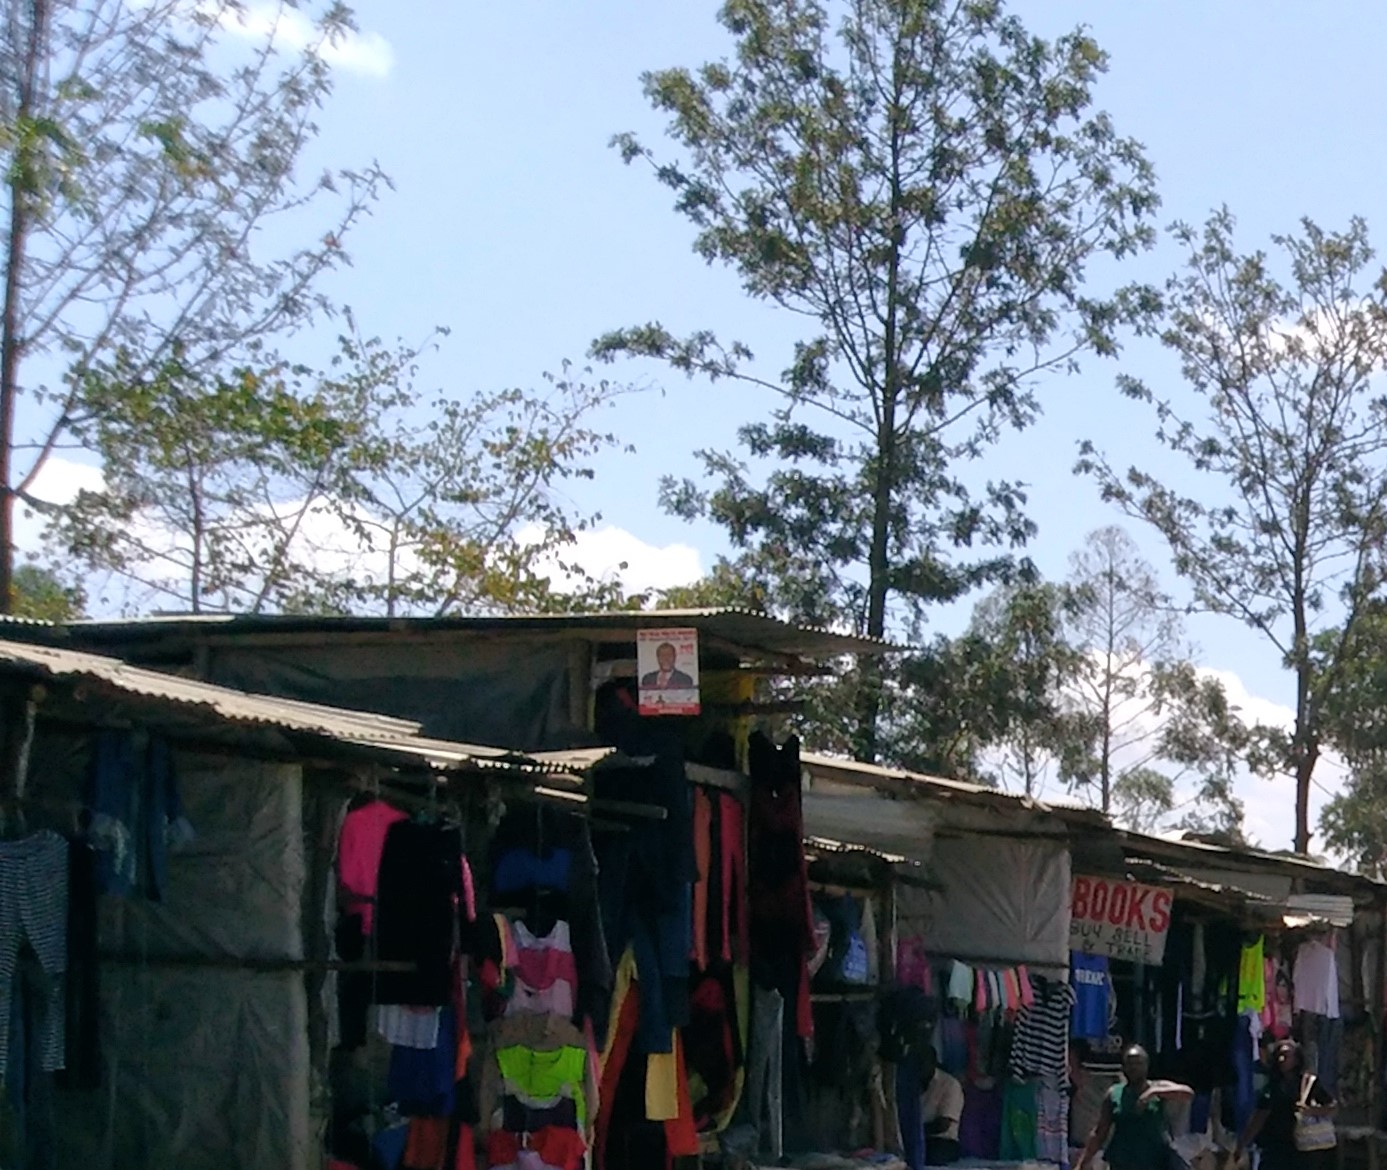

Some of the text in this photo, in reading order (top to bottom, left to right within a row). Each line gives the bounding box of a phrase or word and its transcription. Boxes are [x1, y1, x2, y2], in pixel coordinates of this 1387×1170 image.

[1072, 878, 1171, 933] BOOKS
[1070, 921, 1152, 946] BUY SELL
